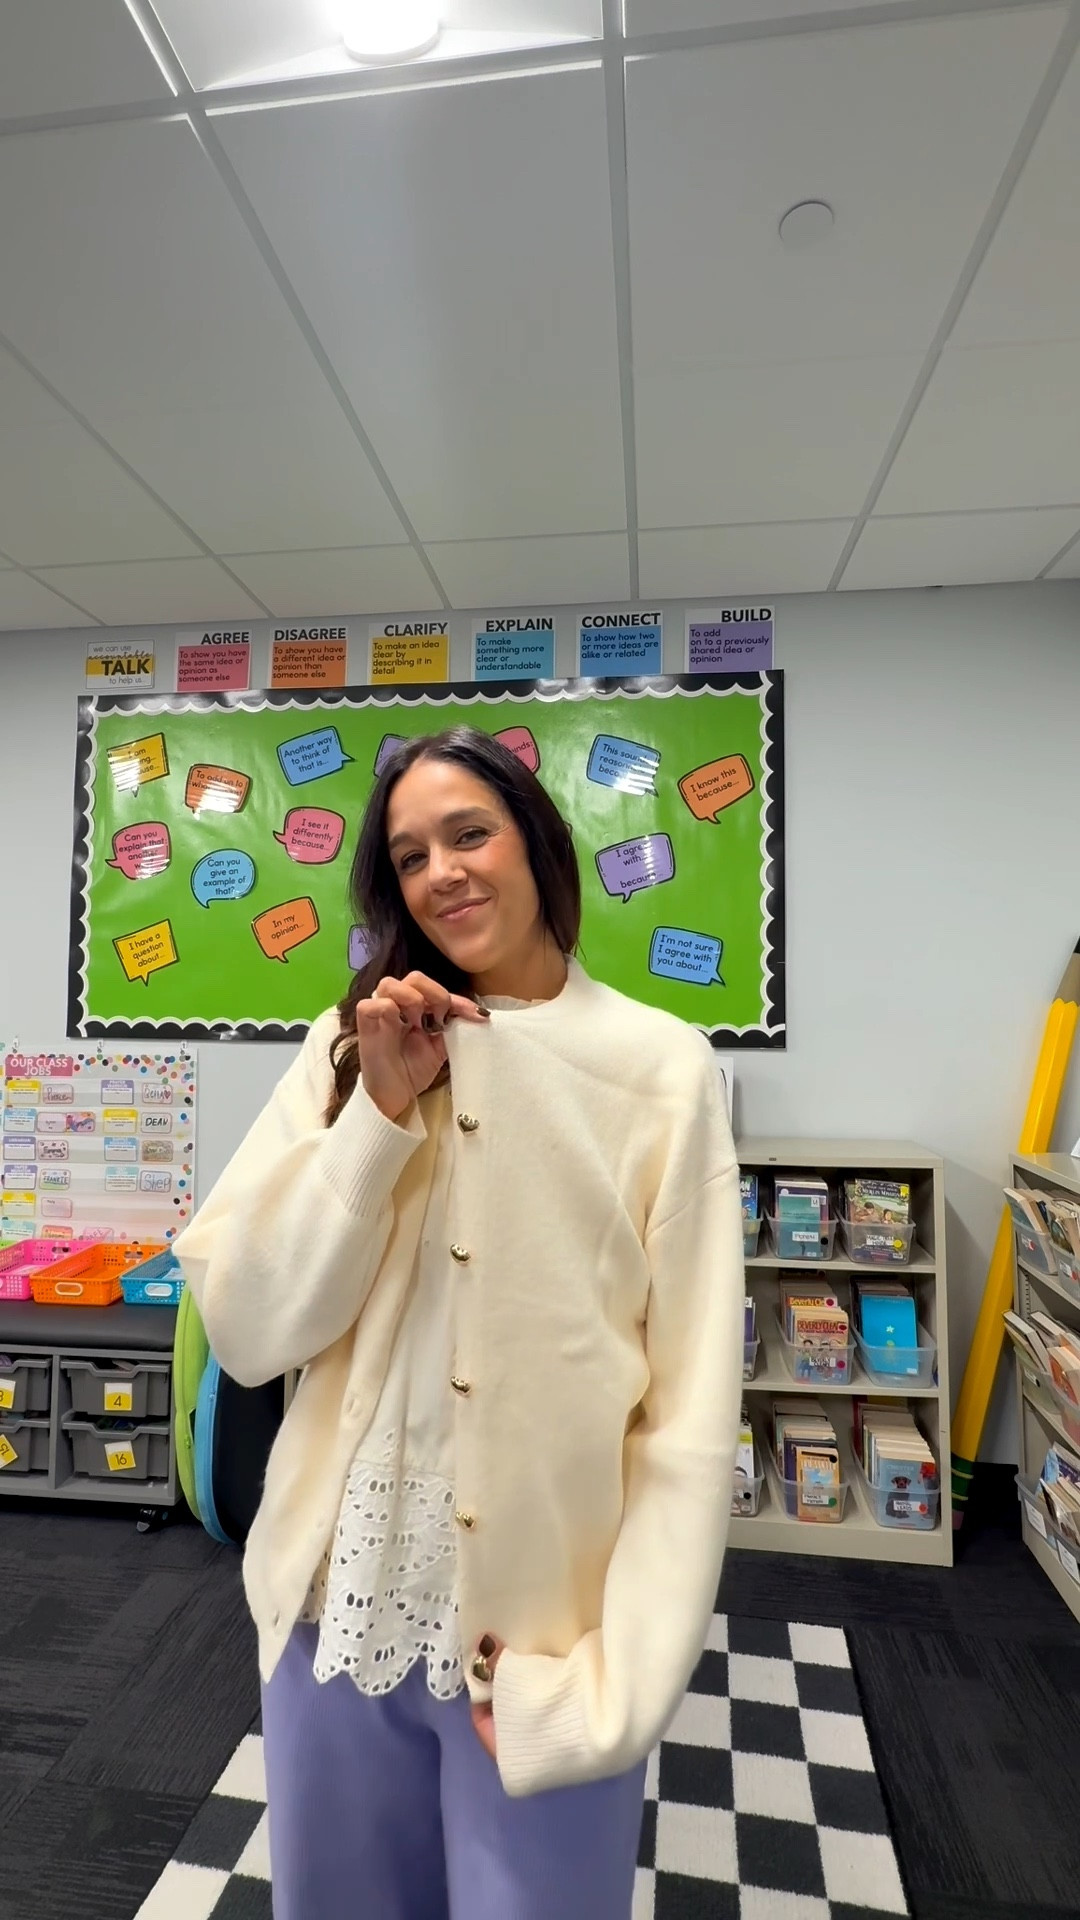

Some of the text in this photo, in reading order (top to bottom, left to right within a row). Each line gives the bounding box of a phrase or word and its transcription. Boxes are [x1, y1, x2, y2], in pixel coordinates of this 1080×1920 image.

[581, 613, 661, 628] CONNECT
[722, 608, 771, 623] BUILD
[384, 622, 448, 637] CLARIFY
[486, 618, 553, 632] EXPLAIN
[201, 632, 249, 645] AGREE
[274, 628, 346, 641] DISAGREE
[582, 634, 592, 642] To
[639, 632, 655, 640] two
[690, 629, 721, 637] To add
[373, 642, 383, 650] To
[421, 640, 440, 648] idea
[477, 637, 512, 646] To make
[705, 638, 714, 646] to
[724, 636, 770, 647] previously
[190, 650, 209, 658] show
[212, 651, 227, 659] you
[285, 646, 305, 654] show
[307, 647, 322, 655] you
[324, 645, 343, 653] have
[373, 650, 406, 660] clear by
[476, 646, 520, 655] something
[581, 651, 601, 659] alike
[615, 649, 646, 658] related
[690, 646, 721, 654] shared
[281, 654, 315, 662] different
[372, 658, 415, 667] describing
[476, 655, 498, 663] clear
[690, 656, 723, 664] opinion
[101, 658, 150, 676] TALK
[178, 667, 207, 675] opinion
[272, 662, 322, 672] opinion than
[372, 667, 396, 675] detail
[476, 661, 542, 670] understandable
[215, 673, 230, 681] else
[311, 670, 326, 678] else
[118, 676, 133, 685] help
[284, 736, 333, 758] Another way
[603, 743, 618, 755] This
[302, 750, 321, 762] think
[322, 745, 330, 755] of
[298, 761, 315, 772] that
[196, 770, 205, 779] To
[235, 780, 243, 788] to
[690, 768, 737, 793] I know this
[301, 818, 306, 826] I
[307, 821, 322, 829] see
[124, 831, 158, 842] Can you
[292, 827, 333, 843] differently
[118, 837, 164, 853] explain that
[616, 844, 647, 858] I agre
[207, 858, 241, 867] Can you
[210, 869, 227, 879] give
[203, 876, 246, 887] example of
[272, 914, 295, 928] In my
[129, 942, 134, 950] I
[134, 937, 154, 948] have
[660, 934, 714, 952] I'm not sure
[132, 942, 164, 961] question
[657, 944, 712, 963] I agree with
[657, 957, 674, 966] you
[10, 1058, 68, 1068] OUR CLASS
[24, 1065, 51, 1076] JOBS
[113, 1395, 122, 1407] 4
[115, 1453, 128, 1466] 16
